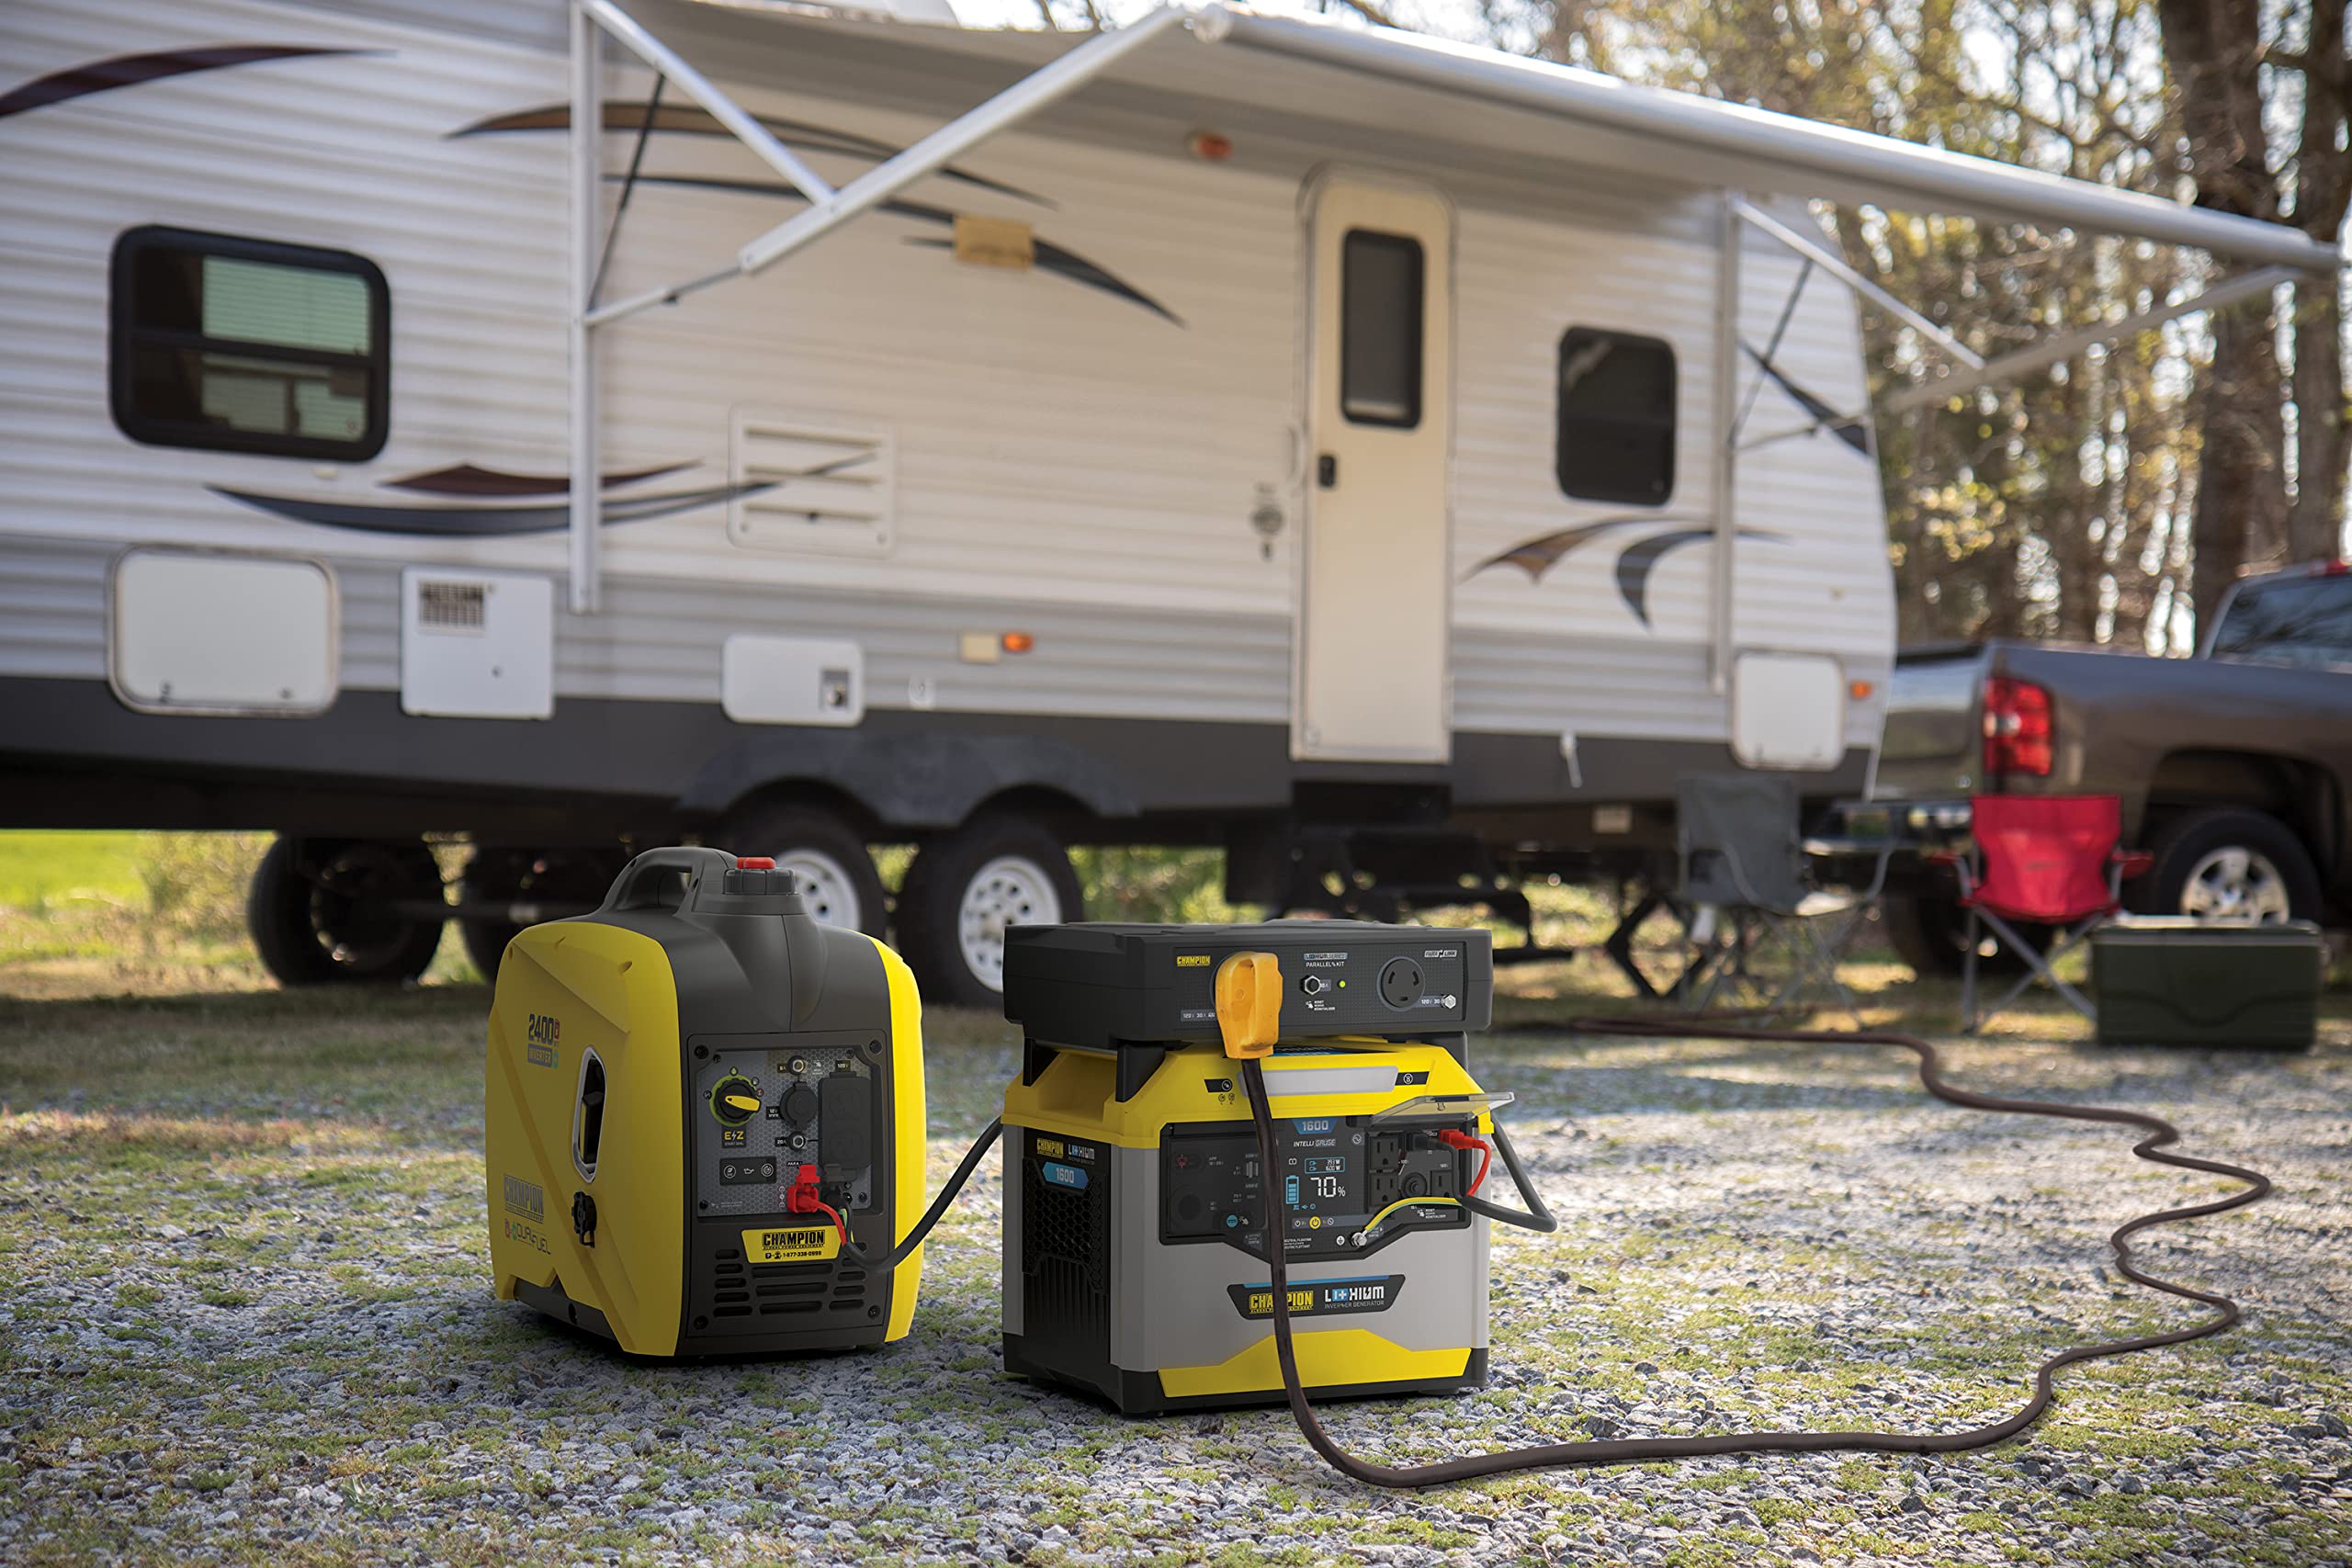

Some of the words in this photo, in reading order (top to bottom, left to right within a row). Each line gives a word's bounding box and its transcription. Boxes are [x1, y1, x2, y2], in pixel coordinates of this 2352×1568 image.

[1176, 955, 1211, 965] CHAMPION
[528, 1013, 554, 1045] 2400
[1302, 1120, 1329, 1132] 1600
[1056, 1167, 1075, 1184] 1600
[503, 1176, 545, 1215] CHAMPION
[763, 1231, 825, 1247] CHAMPION
[1250, 1292, 1314, 1310] CHAPION
